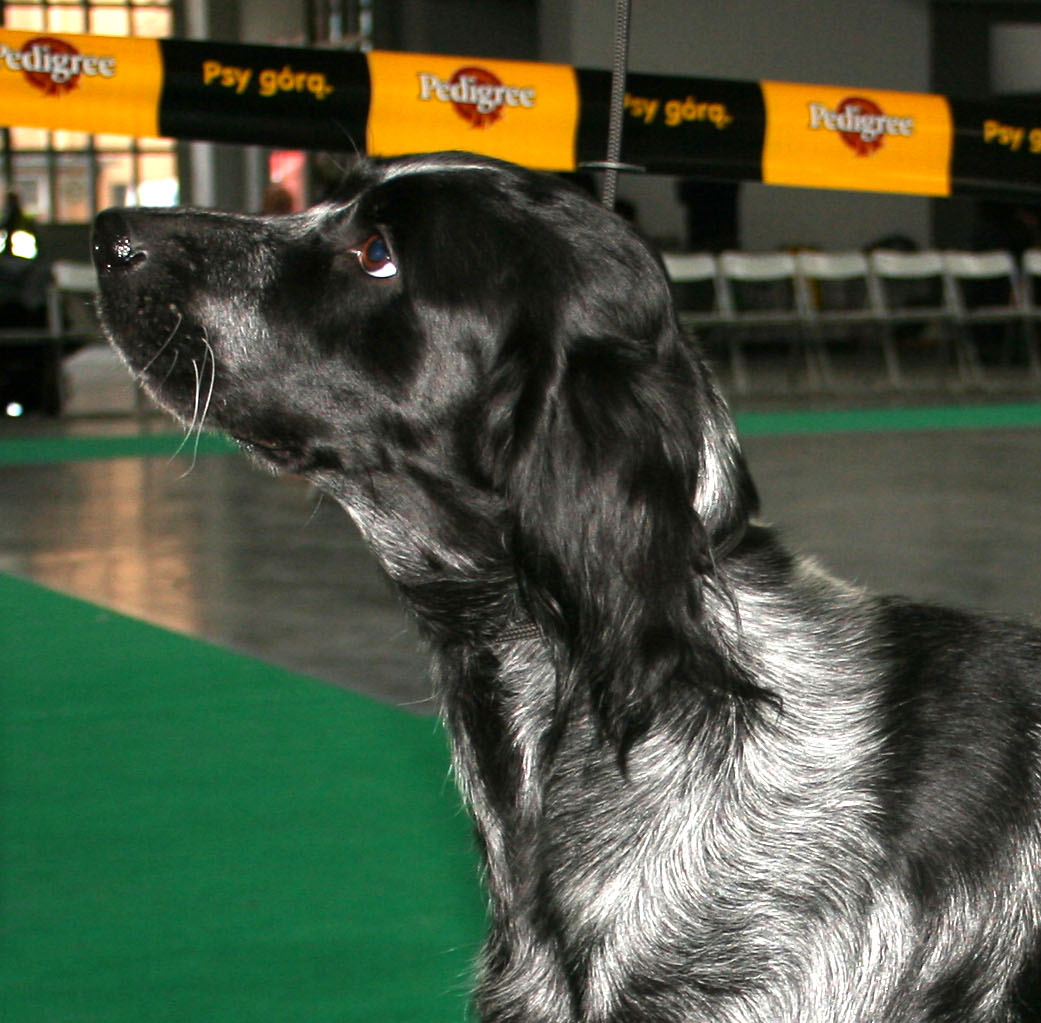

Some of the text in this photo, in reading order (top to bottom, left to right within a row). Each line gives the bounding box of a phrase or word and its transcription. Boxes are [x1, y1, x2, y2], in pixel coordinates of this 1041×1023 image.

[203, 60, 252, 94] Psy
[417, 72, 537, 114] Pedigree
[808, 102, 914, 142] Pedigree
[983, 119, 1024, 152] Psy
